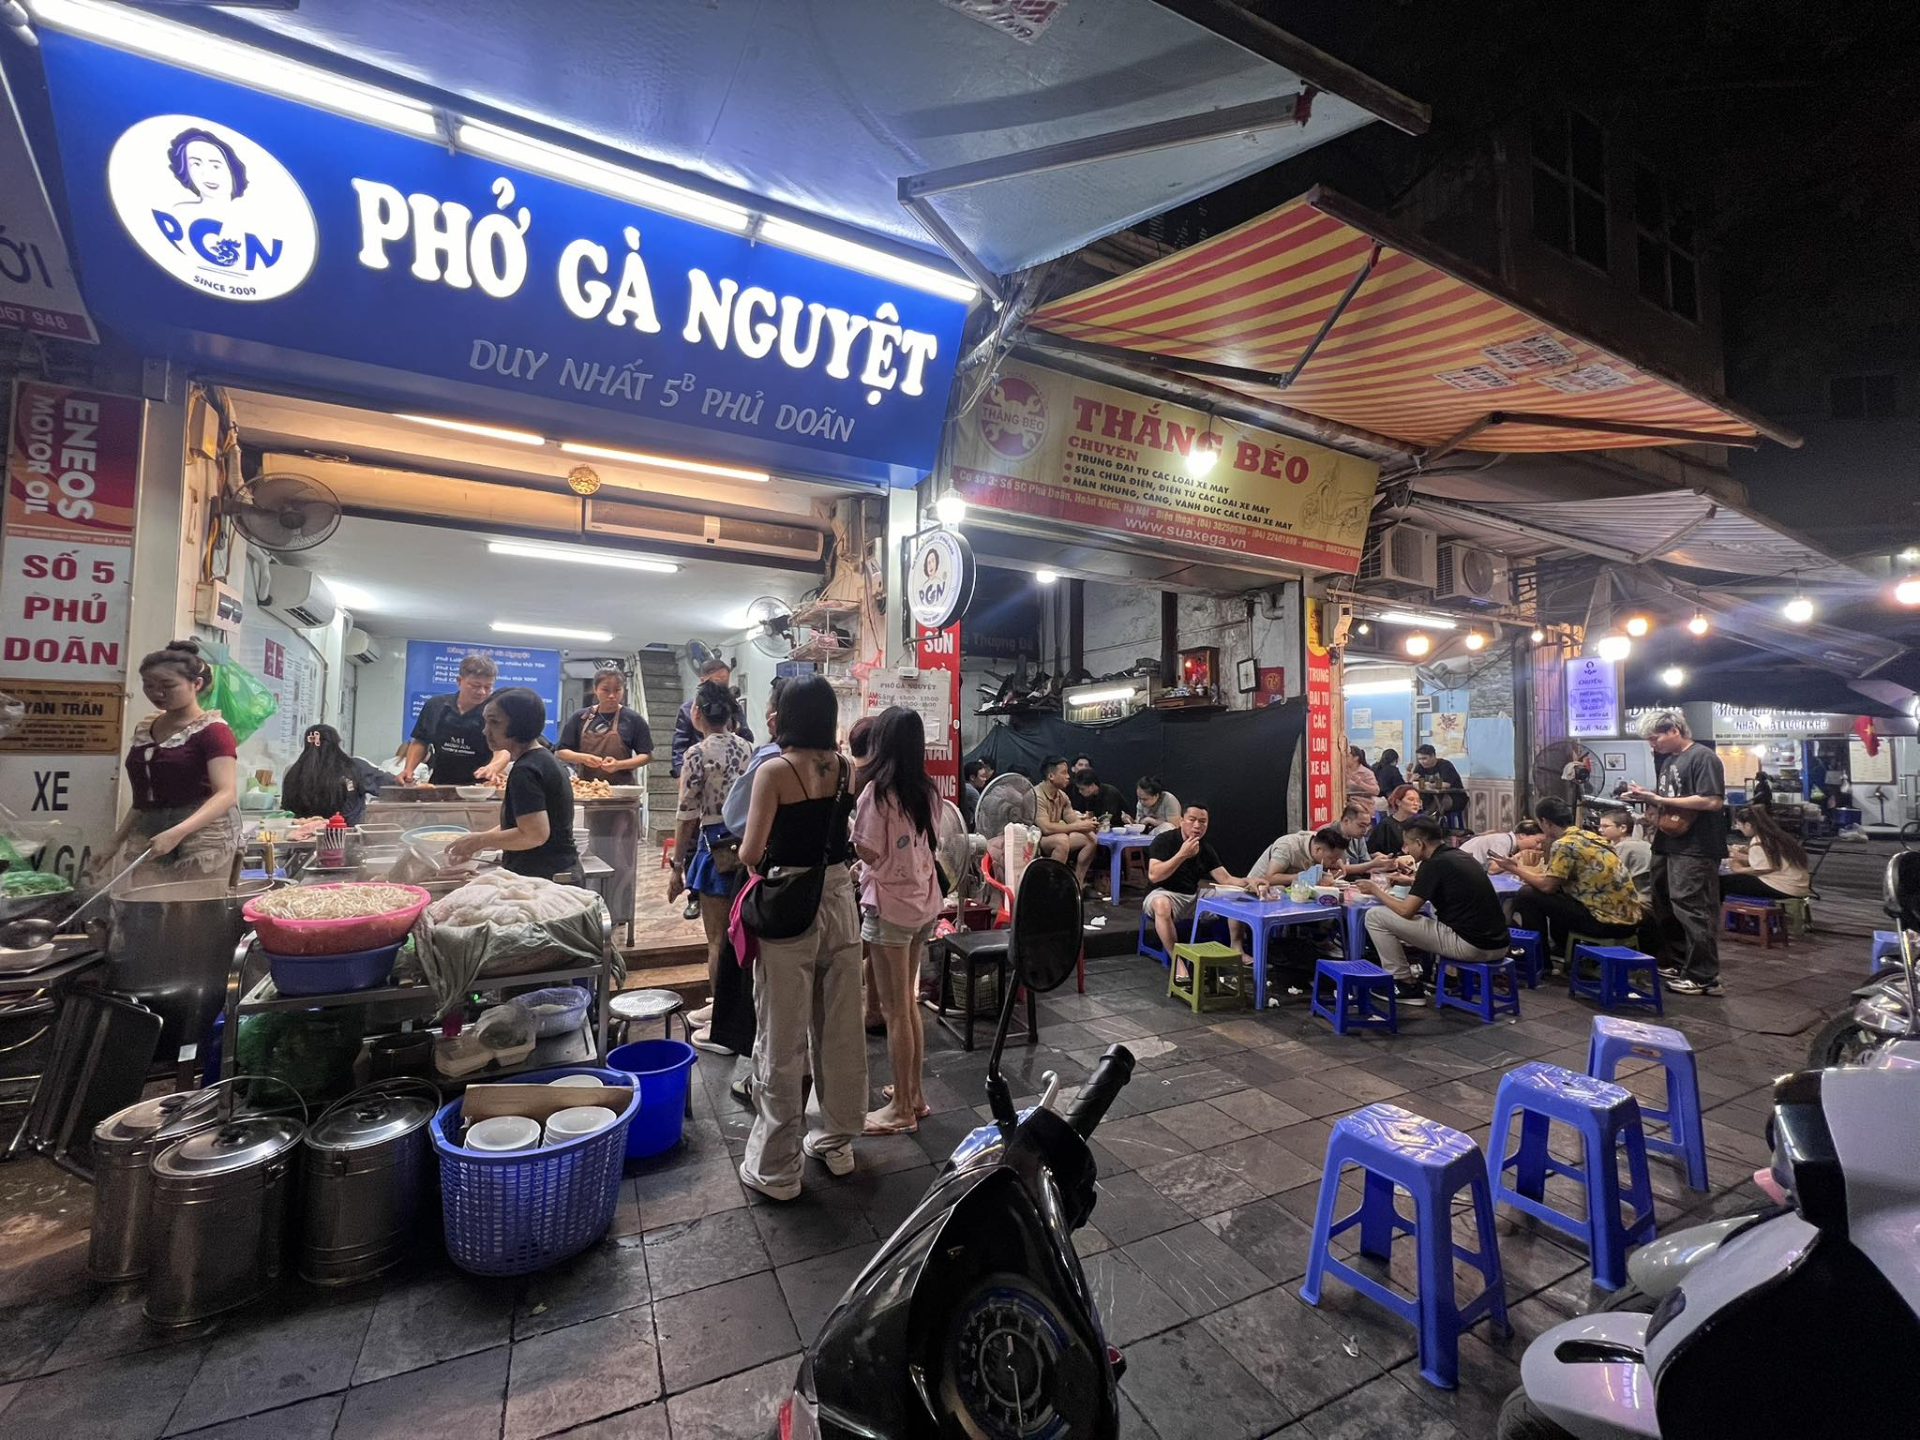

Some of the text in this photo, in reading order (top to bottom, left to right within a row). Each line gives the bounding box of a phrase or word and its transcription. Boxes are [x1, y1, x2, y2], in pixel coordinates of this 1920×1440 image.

[193, 275, 256, 295] SINCE 2009
[351, 177, 937, 405] PHỞ GÀ NGUYỆT
[32, 311, 68, 330] 948
[469, 340, 549, 380] DUY
[559, 358, 653, 401] NHẤT
[702, 388, 765, 425] PHỦ
[775, 404, 855, 442] DOÃN
[28, 394, 55, 474] MOTOR
[1068, 435, 1139, 462] CHUYÊN
[57, 398, 100, 520] ENEOS
[1077, 453, 1112, 468] TRUNG
[1136, 467, 1149, 476] TU
[1196, 480, 1207, 489] XE
[1233, 440, 1309, 484] BÉO
[24, 480, 50, 515] OIL
[1100, 483, 1140, 499] KHUNG,
[1263, 517, 1274, 526] XE
[1239, 501, 1250, 510] XE
[1124, 517, 1247, 549] www.suaxega.vn
[22, 549, 115, 584] SỐ 5
[23, 592, 107, 624] PHỦ
[4, 636, 119, 666] DOÃN
[1308, 666, 1330, 684] TRUNG
[1313, 711, 1327, 729] CÁC
[1312, 737, 1328, 755] LOẠI
[1310, 760, 1331, 776] XE GA
[31, 771, 70, 812] XE
